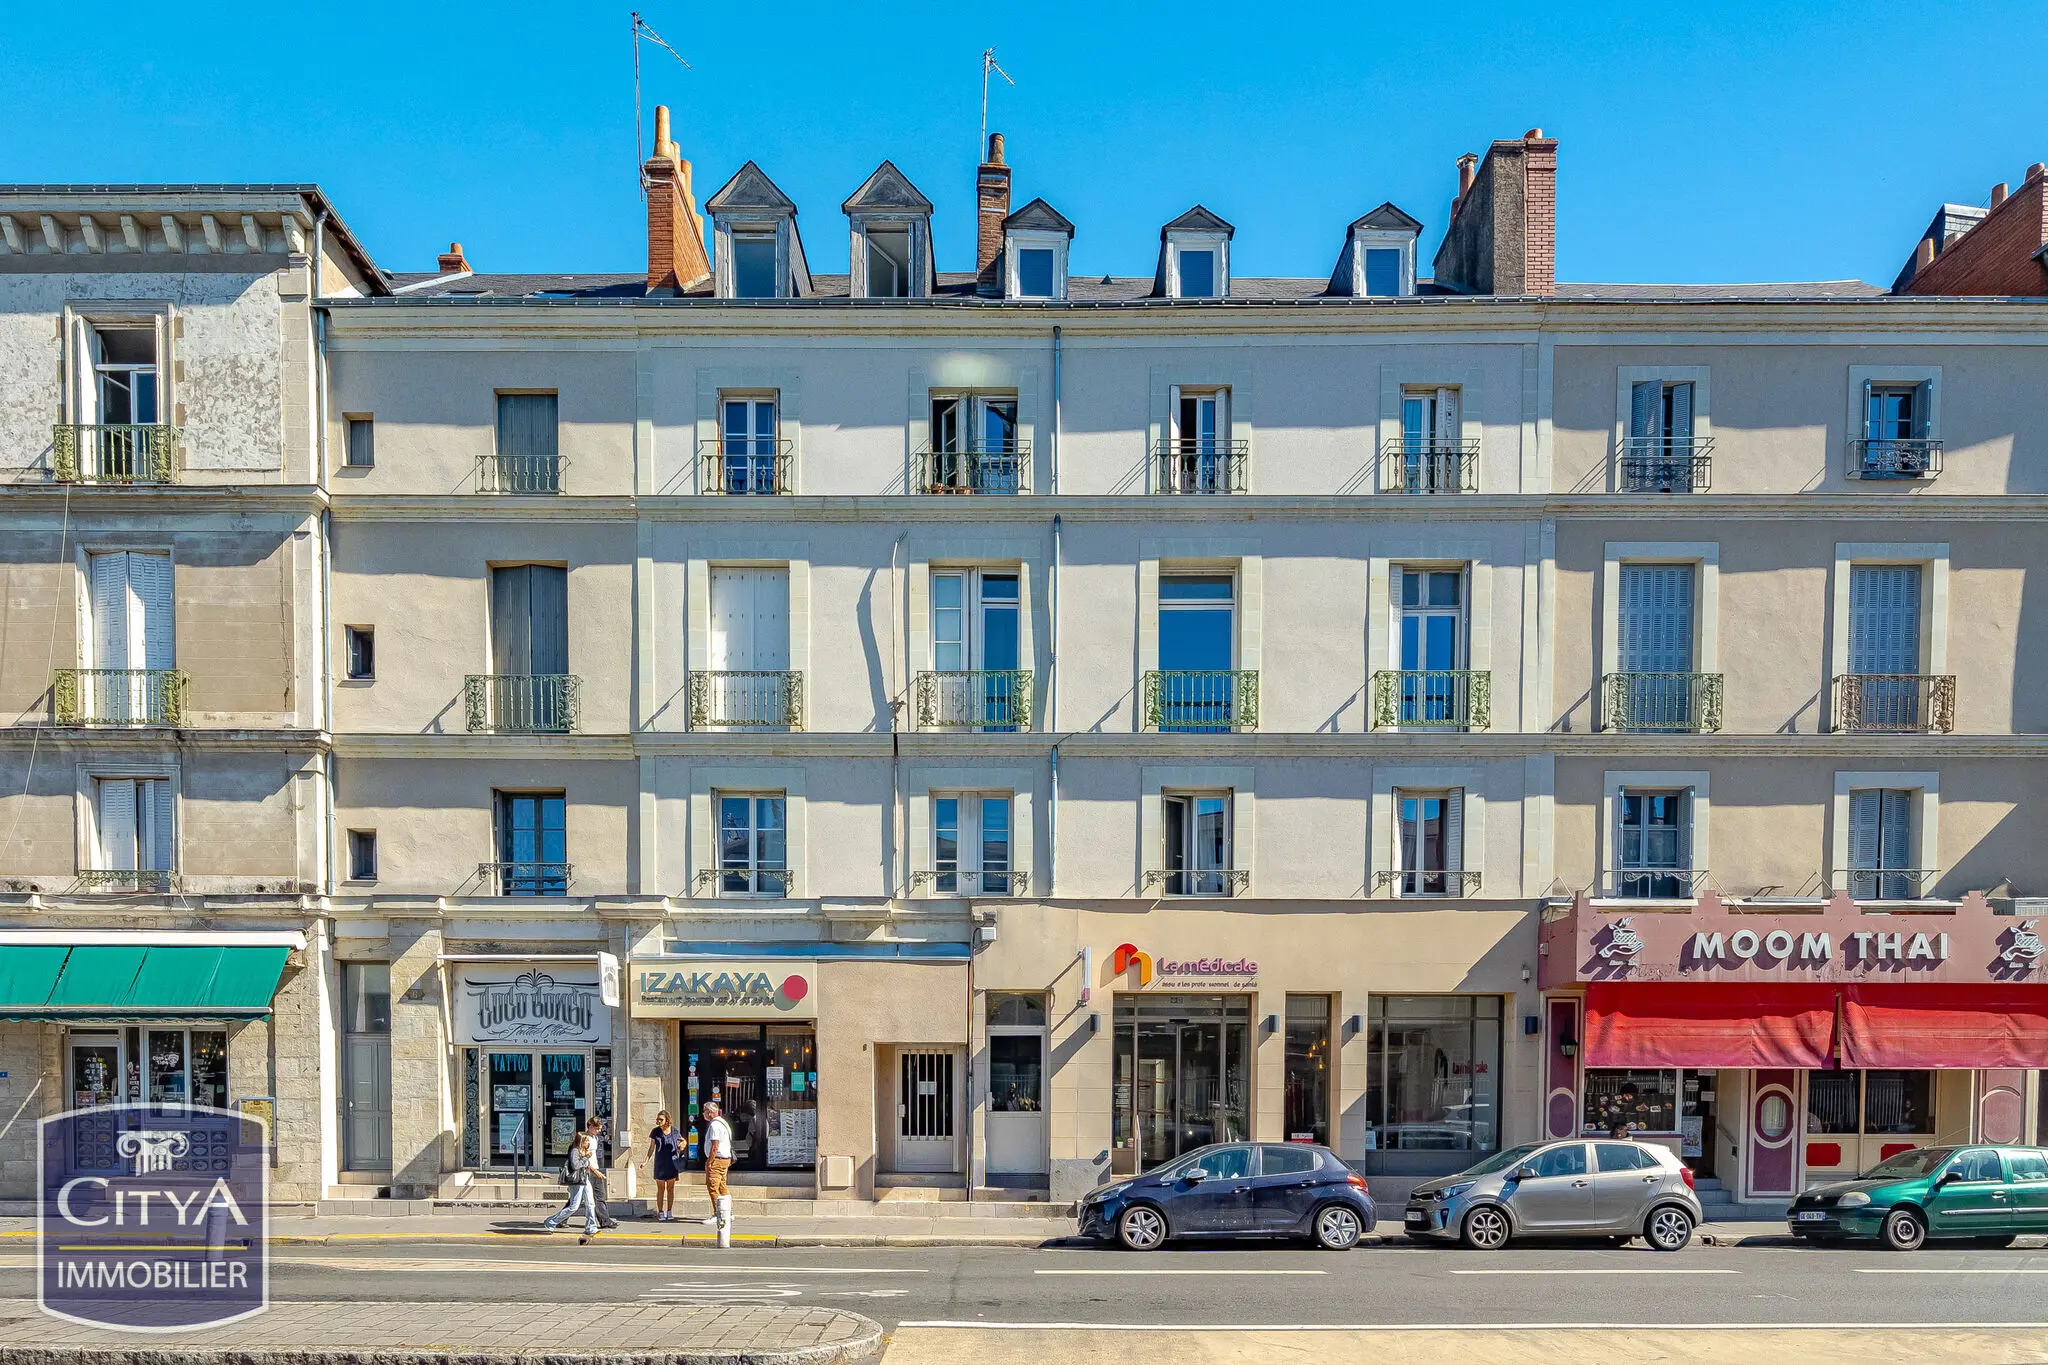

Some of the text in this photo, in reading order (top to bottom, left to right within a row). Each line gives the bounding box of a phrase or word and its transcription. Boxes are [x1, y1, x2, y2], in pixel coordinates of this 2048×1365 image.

[1693, 930, 1948, 959] MOOM THAI
[1160, 957, 1258, 973] La médicale
[641, 972, 775, 994] IZAKAYA
[493, 1054, 529, 1072] TATTOO
[546, 1055, 582, 1073] TATTOO
